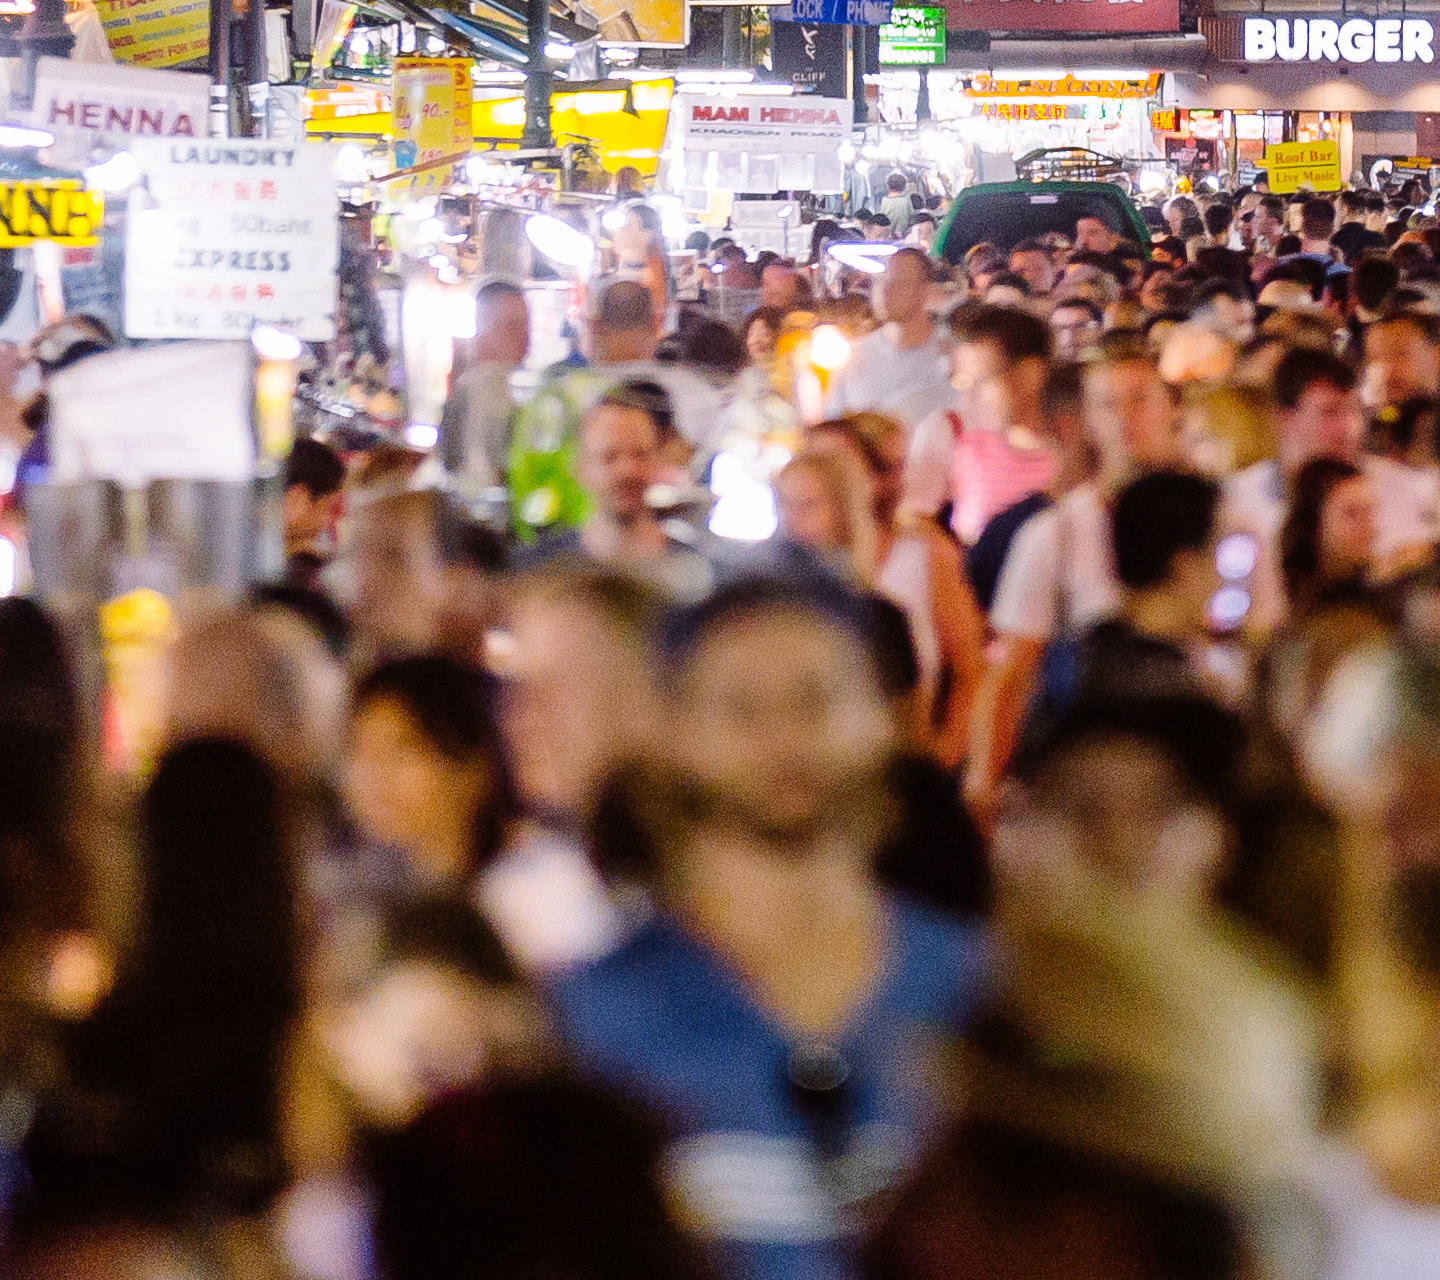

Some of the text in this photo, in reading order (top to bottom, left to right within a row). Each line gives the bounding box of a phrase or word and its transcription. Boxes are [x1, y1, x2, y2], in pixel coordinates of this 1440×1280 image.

[1242, 16, 1436, 64] BURGER
[48, 99, 195, 137] HENNA
[692, 105, 842, 125] MAM HENNA
[689, 128, 781, 137] KHAOSAN
[170, 147, 297, 167] LAUNDRY
[1274, 150, 1333, 165] Roof Bar
[1275, 169, 1335, 184] Live Music
